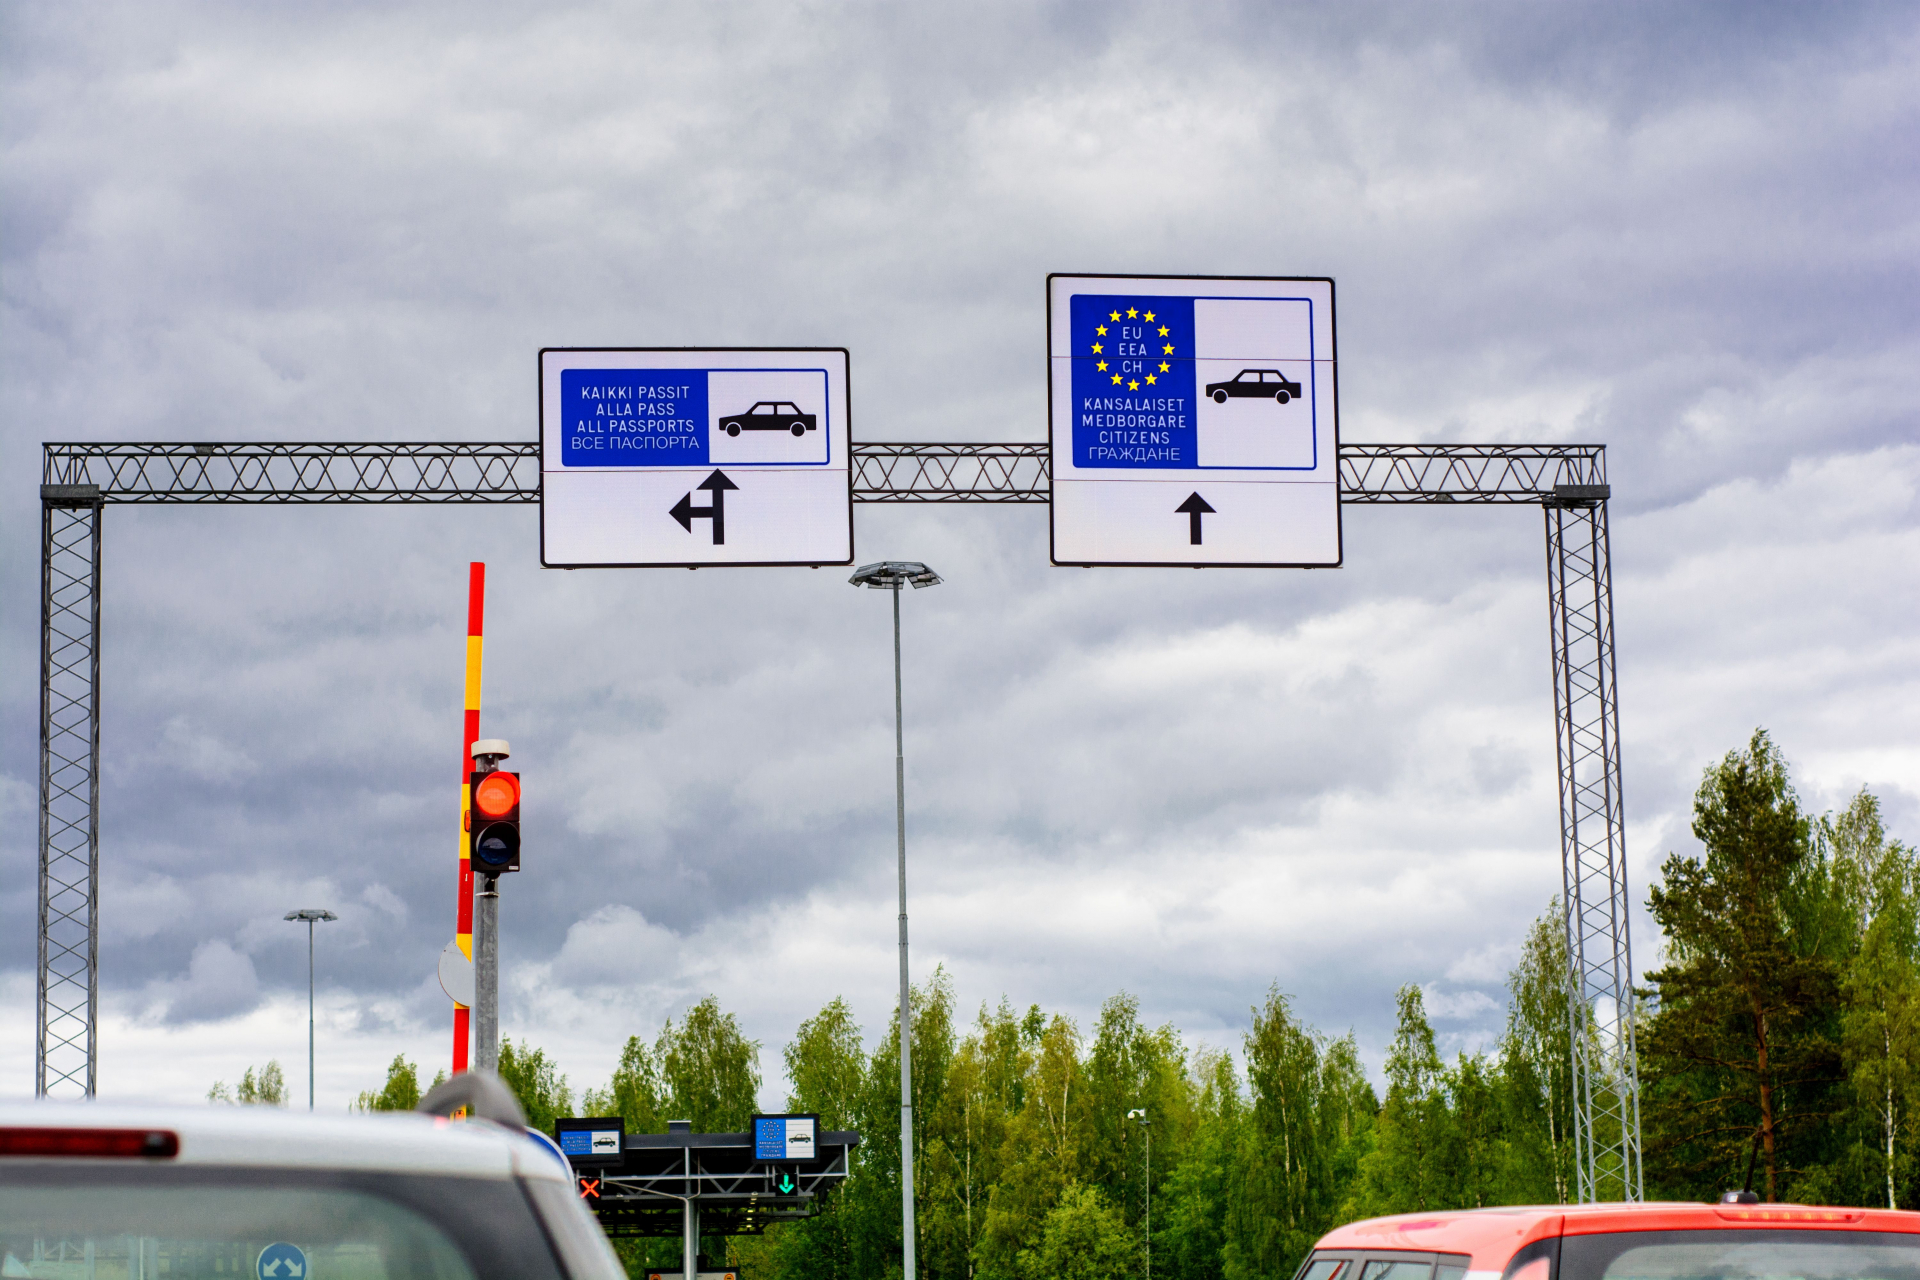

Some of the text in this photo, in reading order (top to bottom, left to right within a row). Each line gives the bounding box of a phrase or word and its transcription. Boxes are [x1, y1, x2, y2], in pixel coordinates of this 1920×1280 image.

[1122, 326, 1142, 339] EU
[1119, 343, 1147, 356] EEA
[1122, 361, 1142, 373] CH
[581, 386, 690, 399] KAIKKI PASSIT
[596, 403, 675, 416] ALLA PASS
[1084, 398, 1185, 411] KANSALAISET
[577, 420, 694, 433] ALL PASSPORTS
[1082, 414, 1186, 428] MEDBORGARE
[571, 436, 700, 450] ВСЕ ПАСПОРТА
[1099, 431, 1170, 444] CITIZENS
[1089, 446, 1181, 462] ГРАЖДАНЕ
